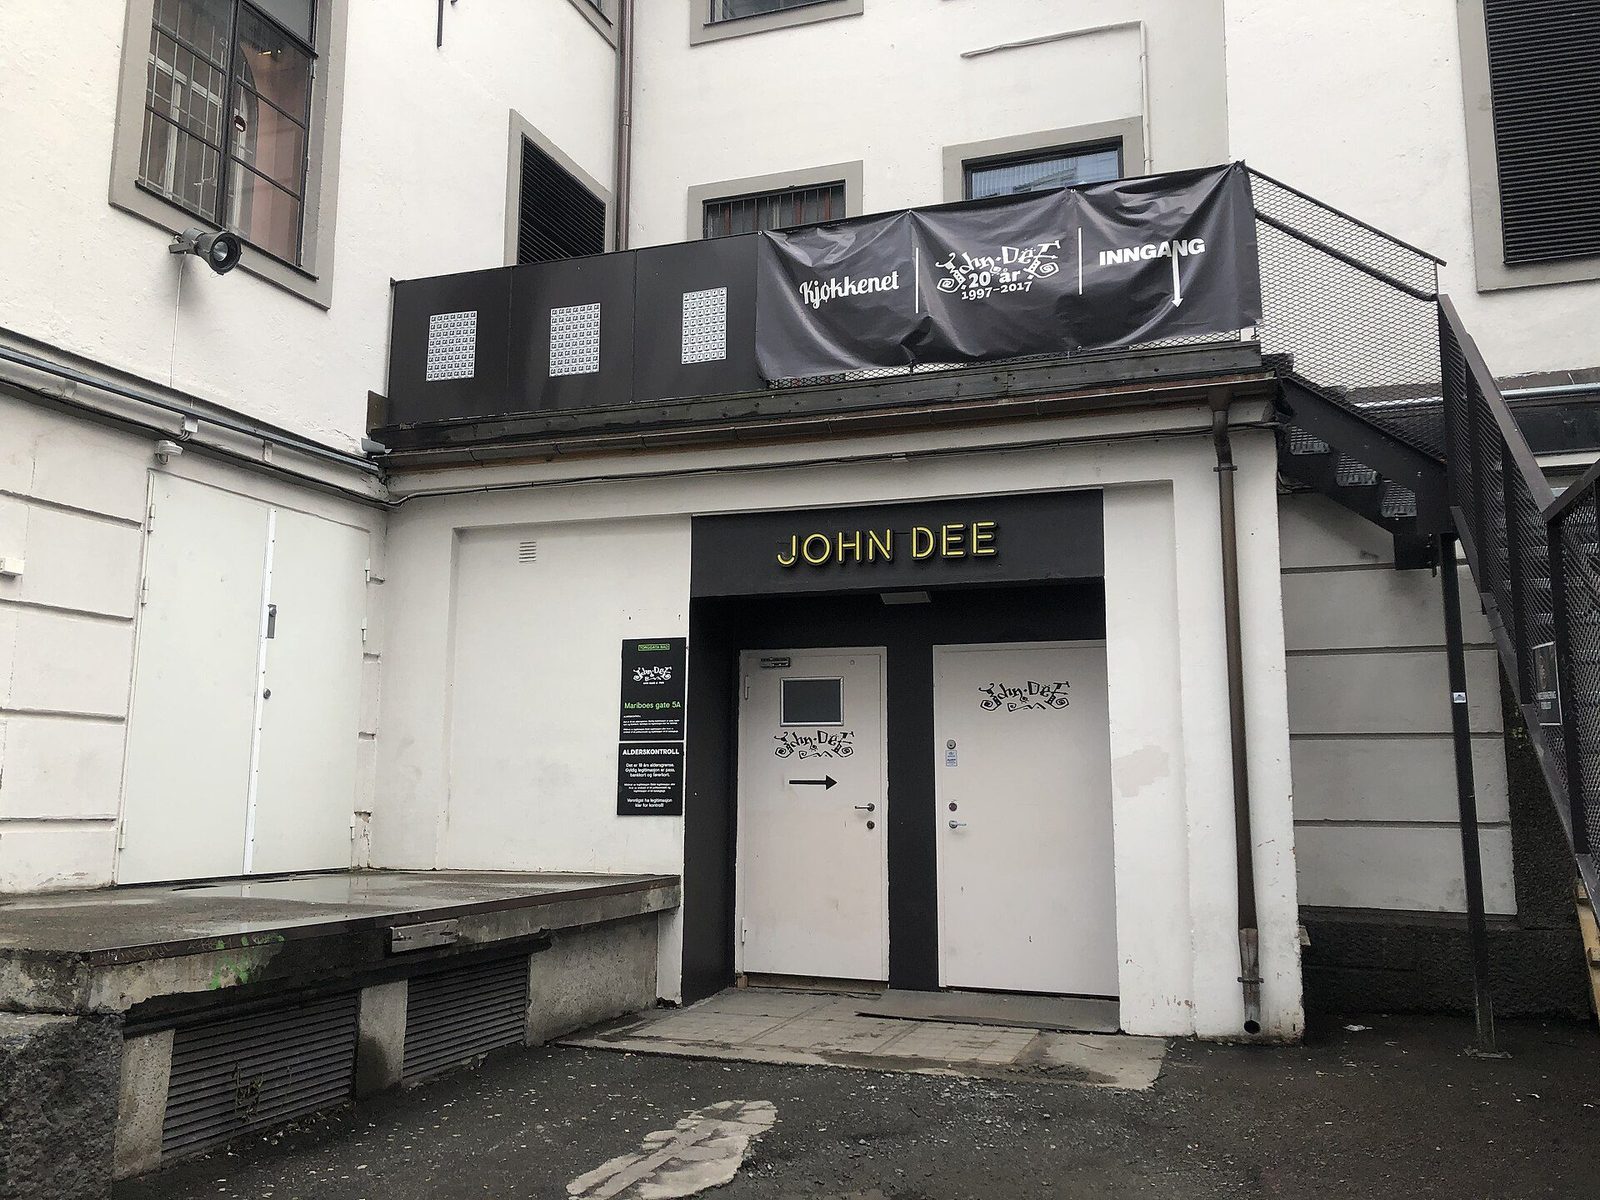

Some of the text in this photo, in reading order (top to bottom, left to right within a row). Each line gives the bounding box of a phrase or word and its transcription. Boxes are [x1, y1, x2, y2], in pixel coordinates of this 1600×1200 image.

[1099, 239, 1206, 266] INNGANG
[968, 267, 1021, 288] 20 år
[799, 271, 900, 309] Kjøkkenet
[777, 521, 996, 566] JOHN DEE
[624, 701, 654, 709] Mariboes
[655, 702, 671, 710] gate
[622, 748, 680, 756] ALDERSKONTROLL
